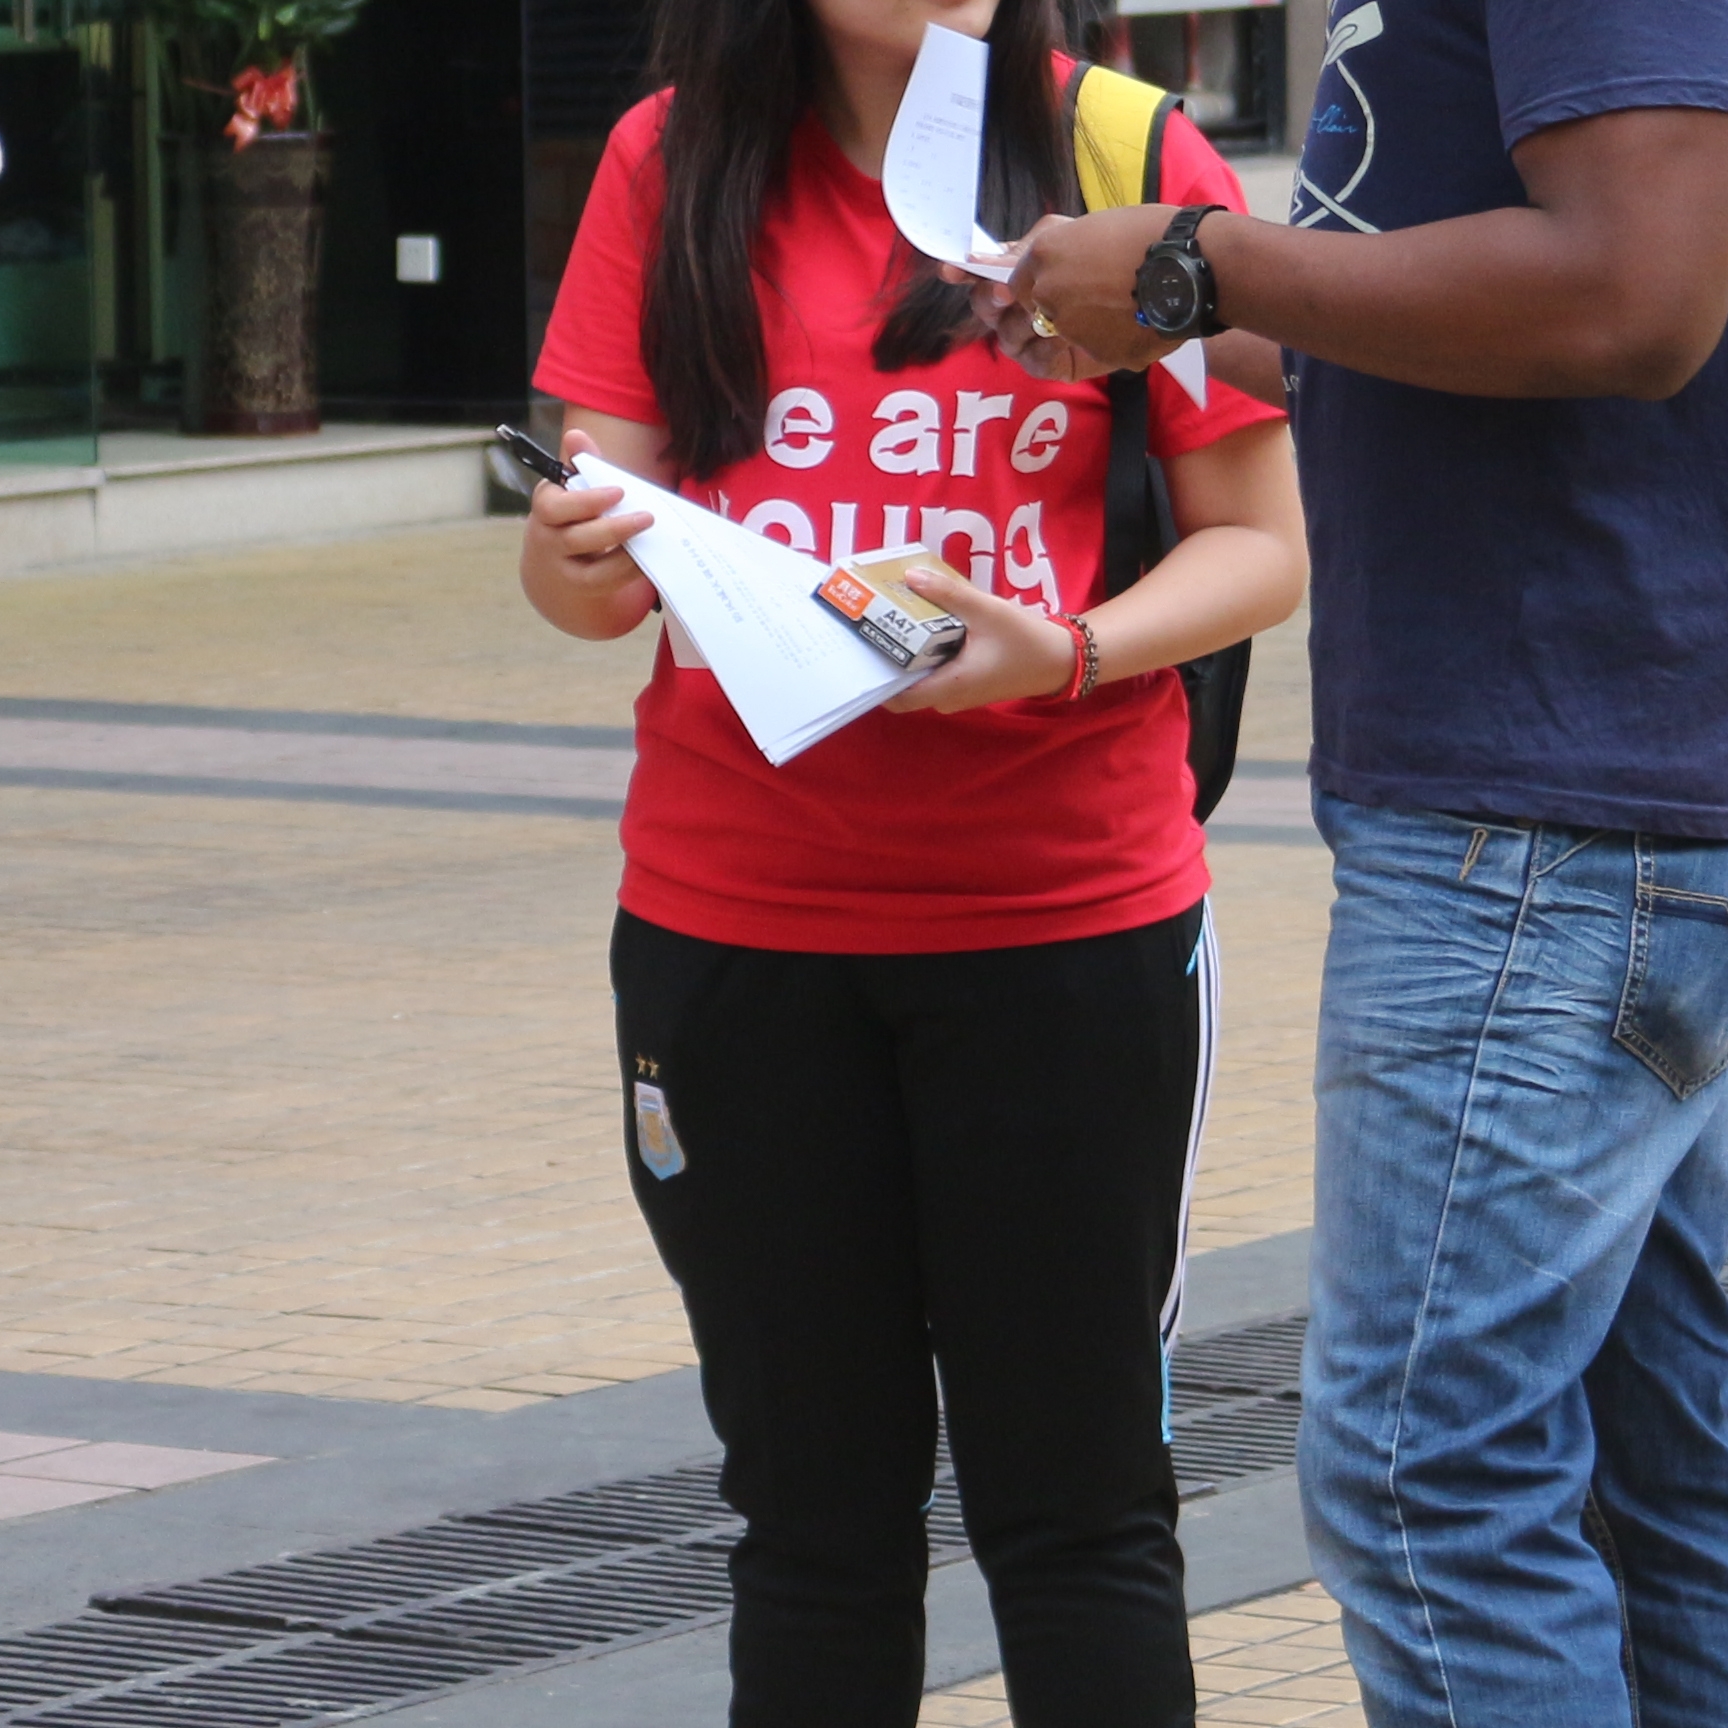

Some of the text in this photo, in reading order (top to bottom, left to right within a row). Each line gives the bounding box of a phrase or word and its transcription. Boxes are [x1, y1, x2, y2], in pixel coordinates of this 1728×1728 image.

[765, 387, 1069, 475] e are
[709, 499, 1064, 617] oung
[882, 608, 917, 635] A47
